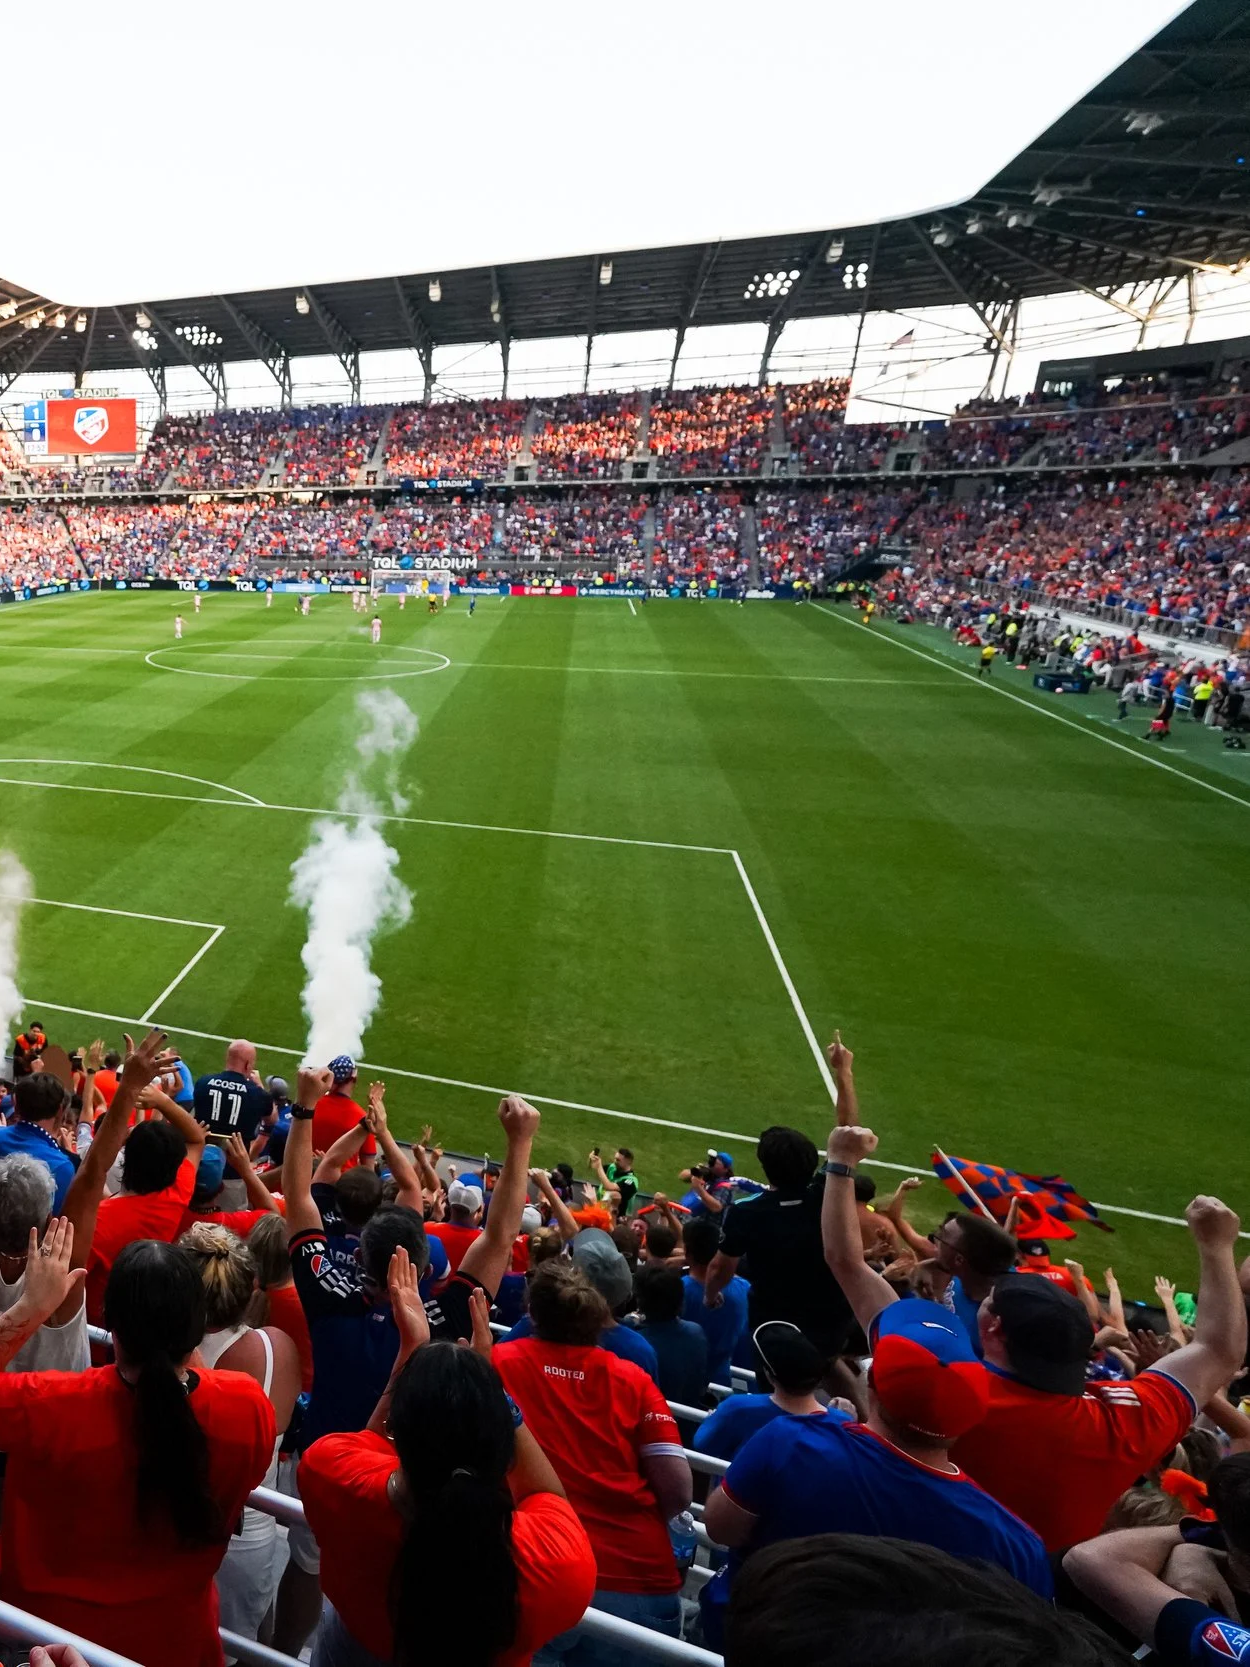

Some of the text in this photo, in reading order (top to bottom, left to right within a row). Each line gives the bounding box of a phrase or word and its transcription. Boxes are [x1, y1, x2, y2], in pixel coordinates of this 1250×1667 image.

[41, 388, 120, 399] TQL STADIUM
[372, 556, 478, 569] TQL STADIUM
[177, 581, 199, 591] TQL
[235, 581, 256, 592] TQL
[650, 588, 669, 598] TQL
[207, 1078, 248, 1093] ACOSTA
[208, 1089, 242, 1126] 11
[544, 1365, 585, 1380] ROOTED
